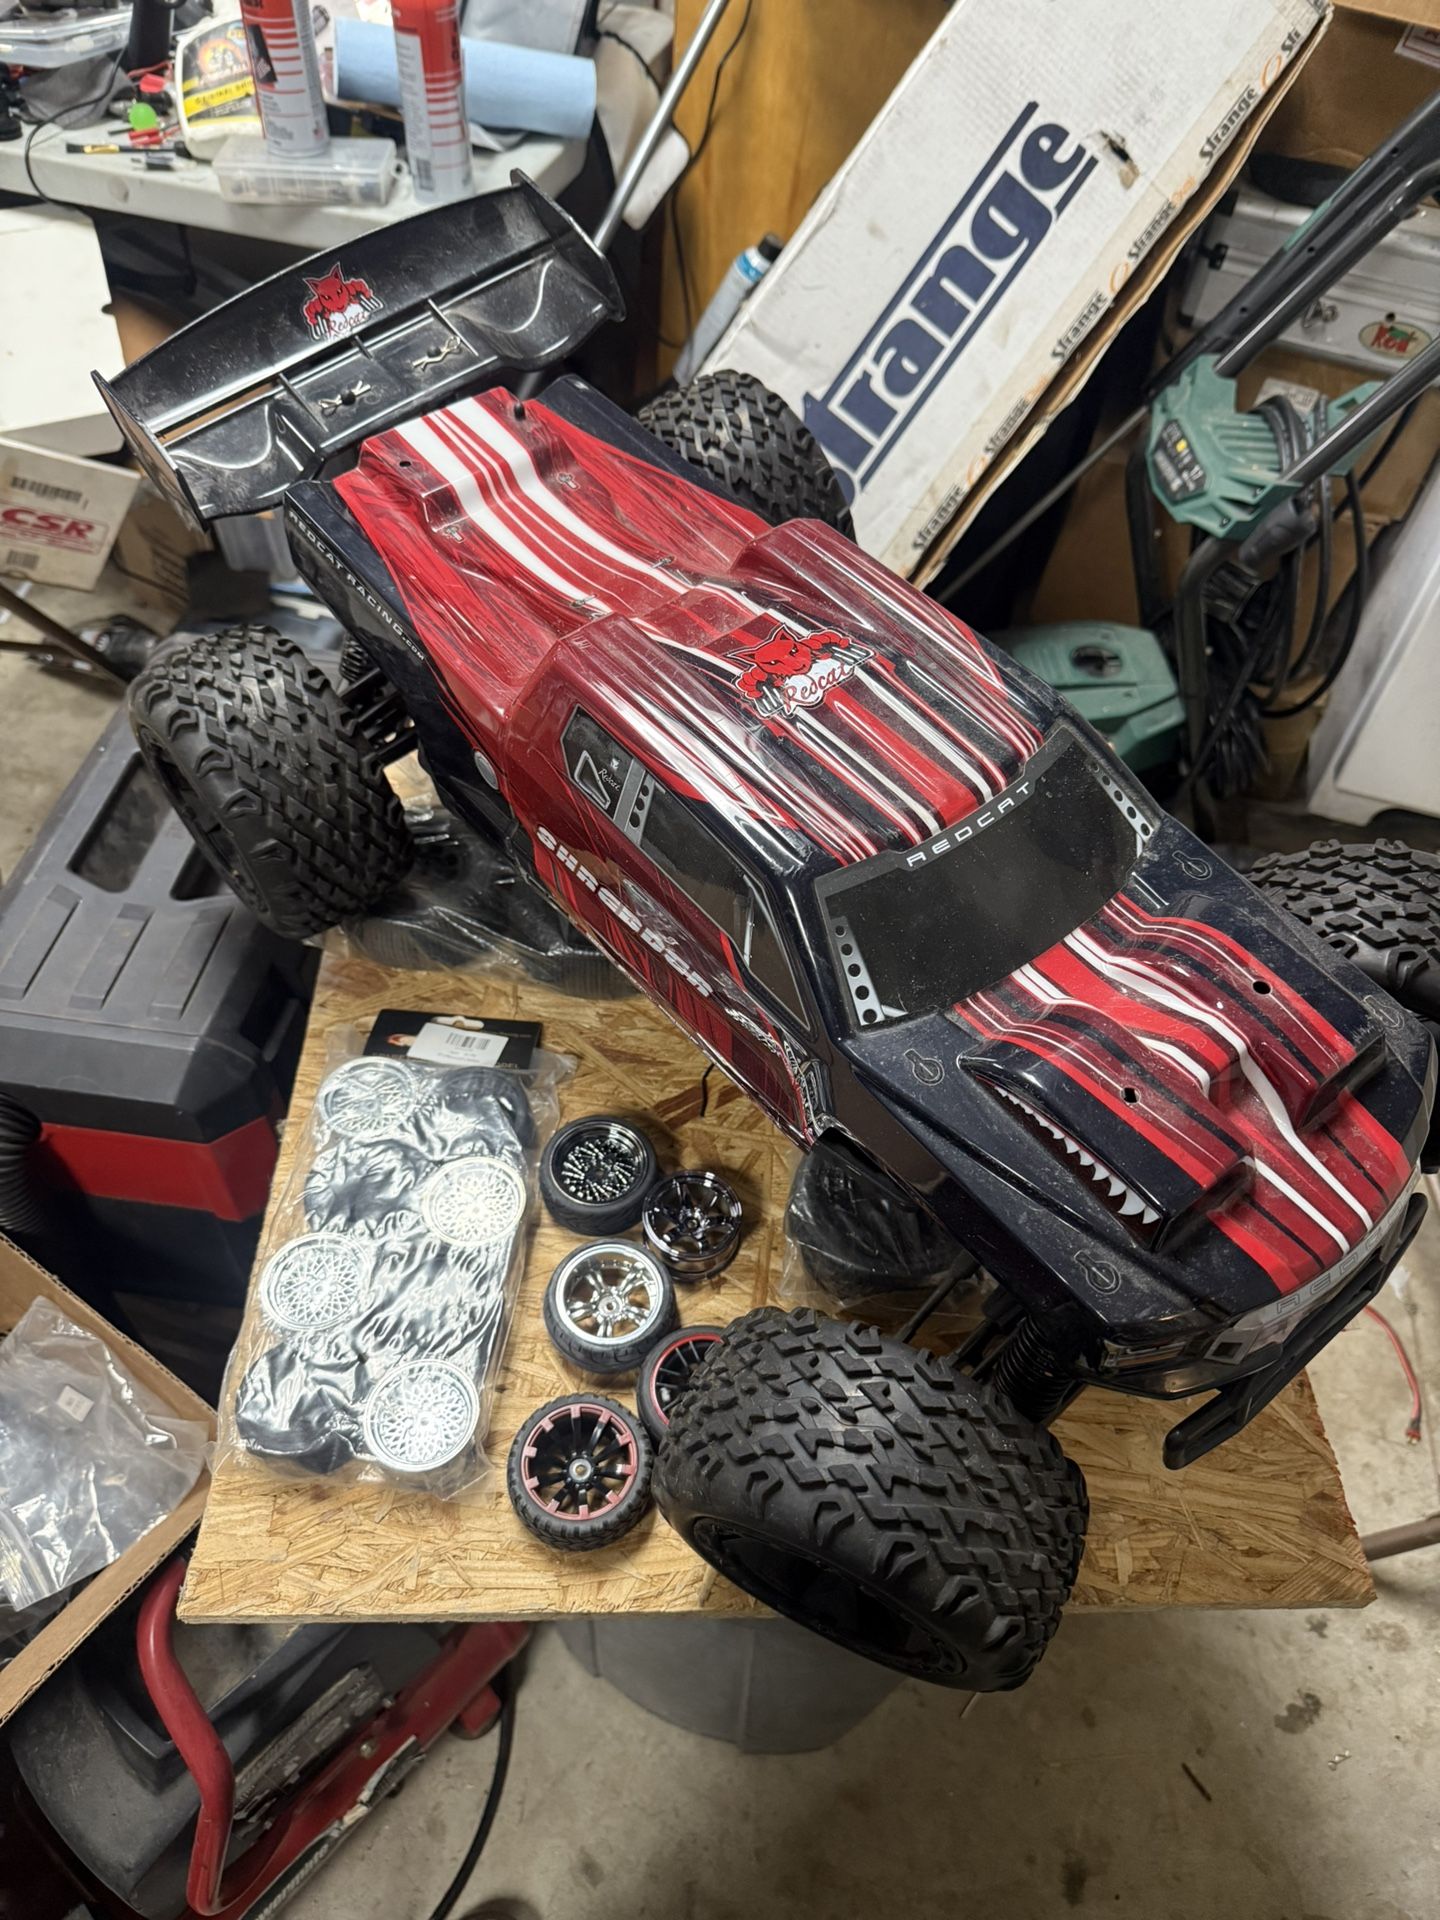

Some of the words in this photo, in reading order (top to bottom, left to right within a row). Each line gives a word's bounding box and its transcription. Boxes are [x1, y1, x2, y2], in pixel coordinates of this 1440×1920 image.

[1198, 84, 1258, 167] Strange
[800, 122, 1088, 502] trange
[1051, 290, 1108, 364] Strange
[1, 508, 95, 540] CSR
[288, 510, 344, 570] REDCAT
[783, 661, 849, 716] Redcat
[906, 781, 1029, 868] REDCAT
